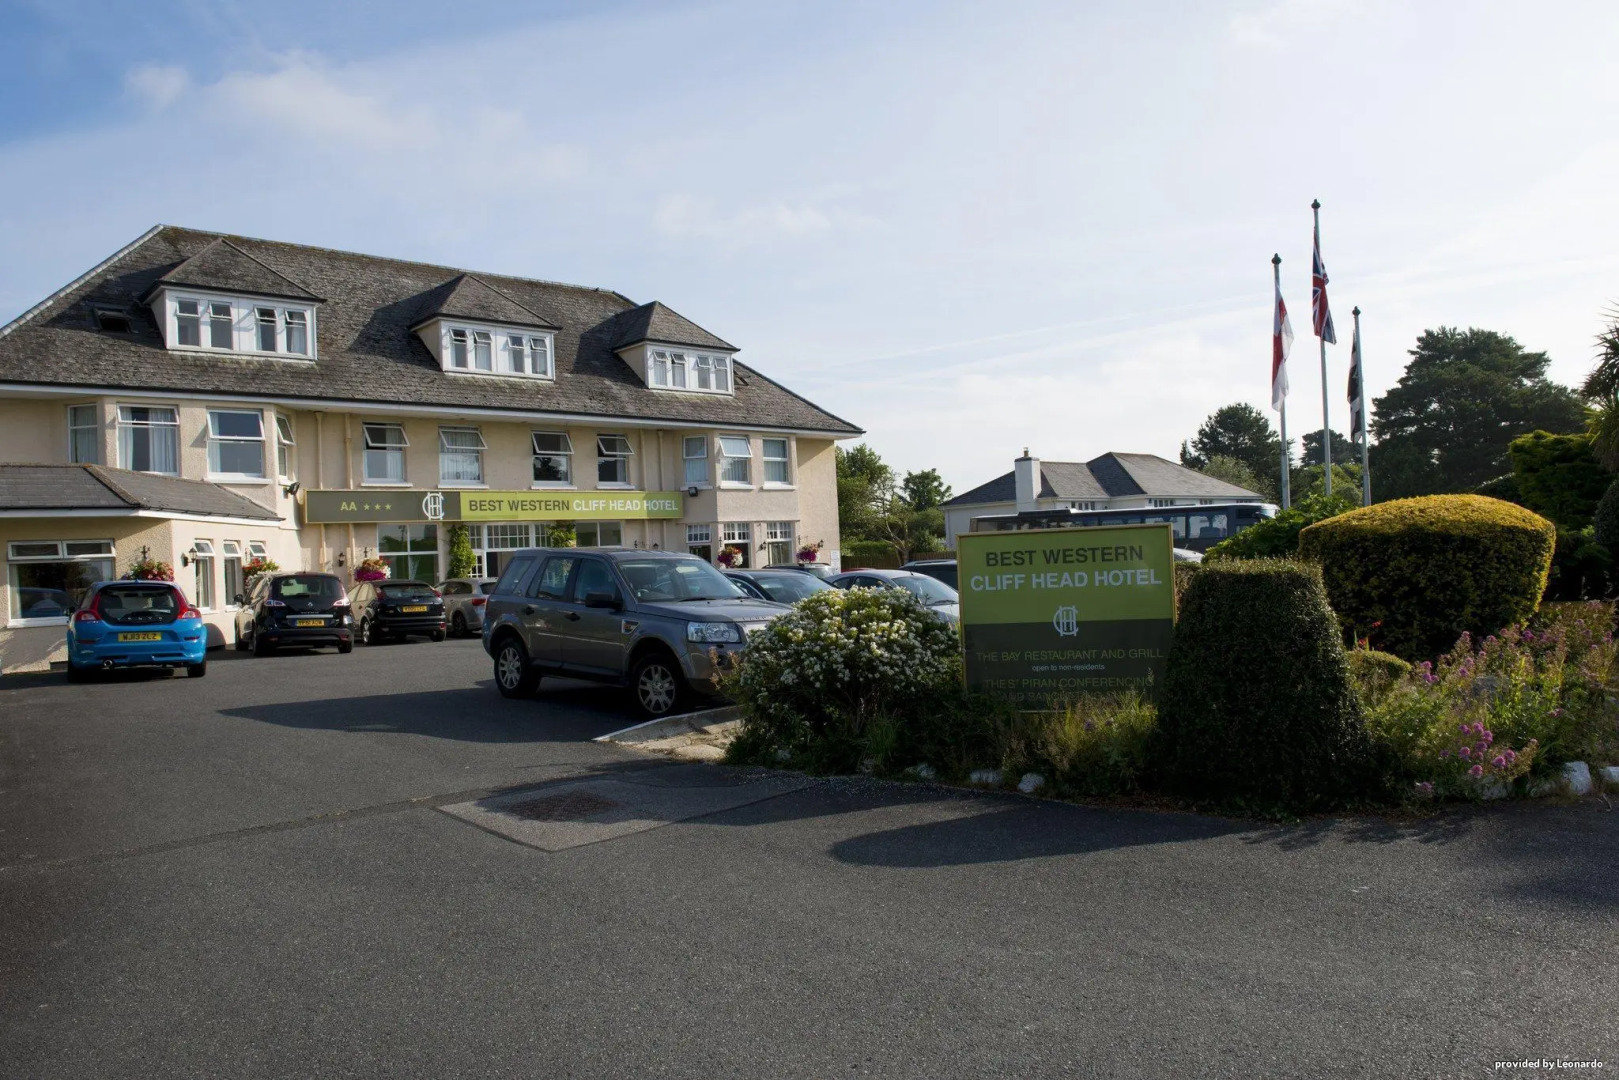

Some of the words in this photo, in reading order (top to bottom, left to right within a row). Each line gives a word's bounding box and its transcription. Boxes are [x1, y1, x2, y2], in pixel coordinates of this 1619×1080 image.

[340, 501, 357, 511] AA
[468, 500, 504, 512] BEST
[508, 500, 570, 511] WESTERN
[573, 500, 606, 511] CLIFF
[609, 500, 640, 511] HEAD
[643, 500, 678, 511] HOTEL
[985, 550, 1036, 567] BEST
[1043, 545, 1143, 565] WESTERN
[970, 574, 1025, 591] CLIFF
[1031, 571, 1088, 589] HEAD
[1094, 568, 1162, 587] HOTEL
[976, 651, 998, 662] THE
[1001, 651, 1021, 661] BAY
[1024, 650, 1097, 661] RESTAURANT
[1101, 649, 1126, 659] AND
[1129, 648, 1164, 659] GRILL
[1031, 665, 1049, 673] open
[1059, 663, 1105, 671] non-residents
[984, 679, 1006, 689] THE
[1022, 679, 1056, 688] PIRAN
[1059, 677, 1155, 688] CONFERENCING
